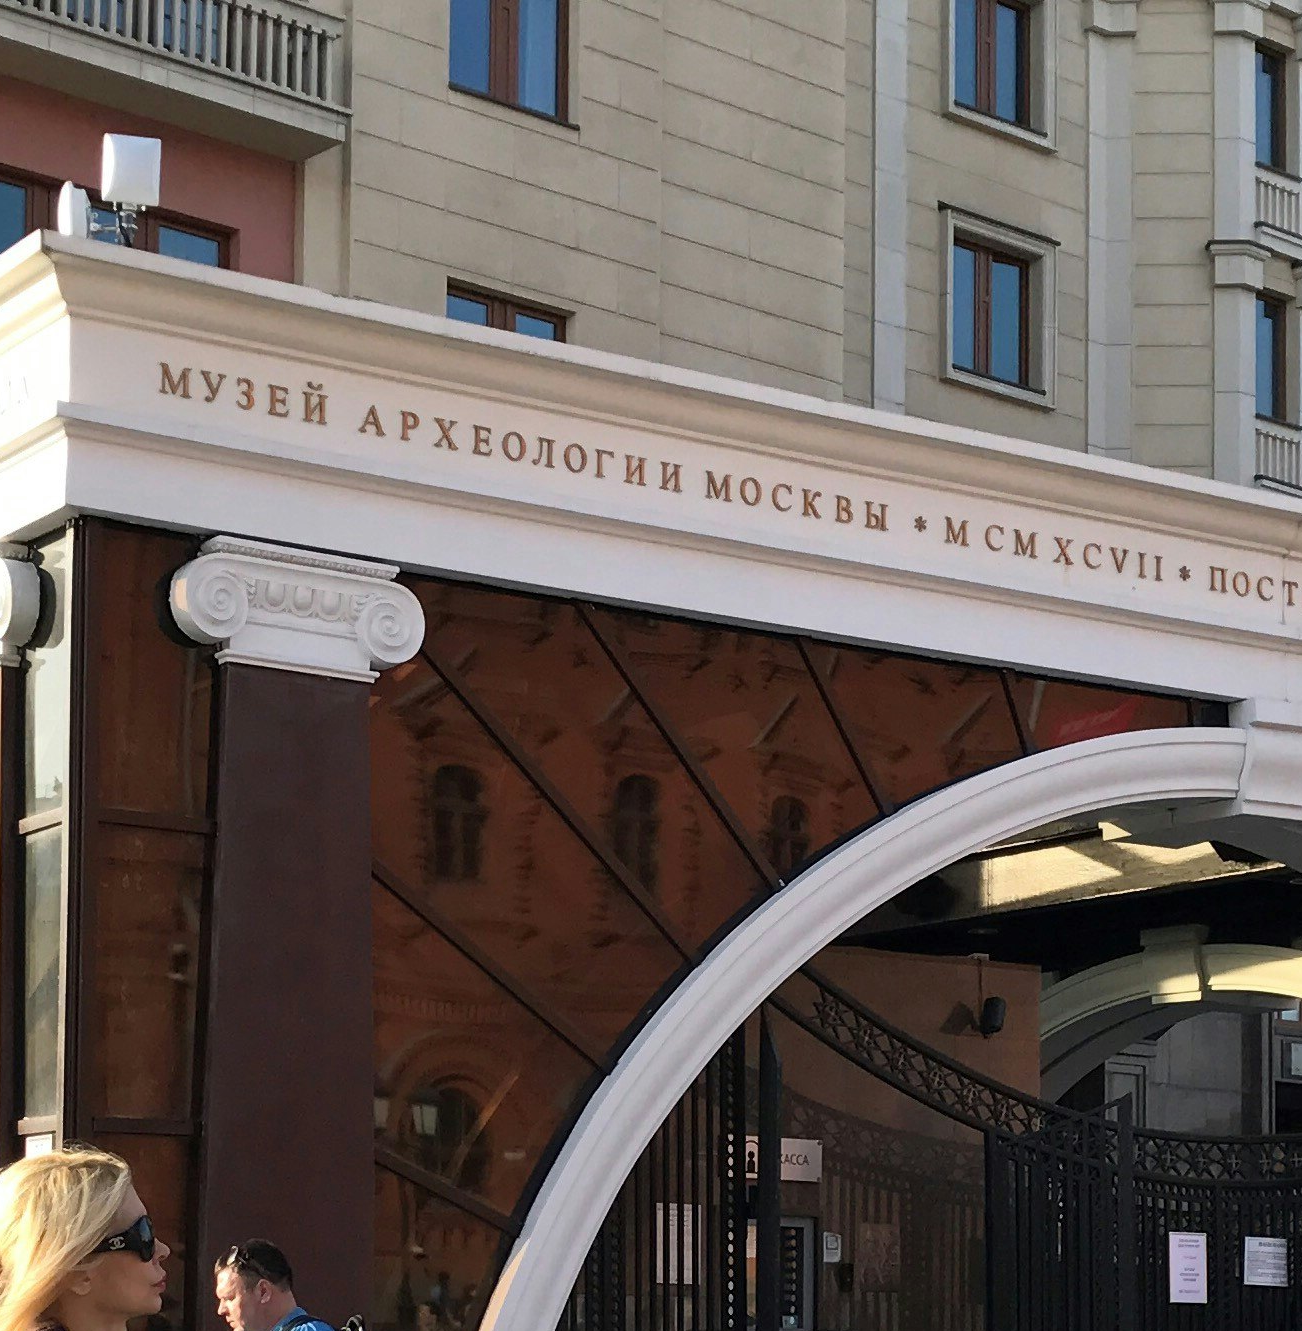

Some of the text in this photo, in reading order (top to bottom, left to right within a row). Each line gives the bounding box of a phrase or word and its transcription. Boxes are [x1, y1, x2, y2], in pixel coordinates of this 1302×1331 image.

[158, 361, 329, 427] МУЗЕЙ
[357, 404, 684, 494] АРХЕОЛОГИИ
[704, 469, 890, 533] МОСКВЫ
[943, 515, 1164, 583] MCMXCVII
